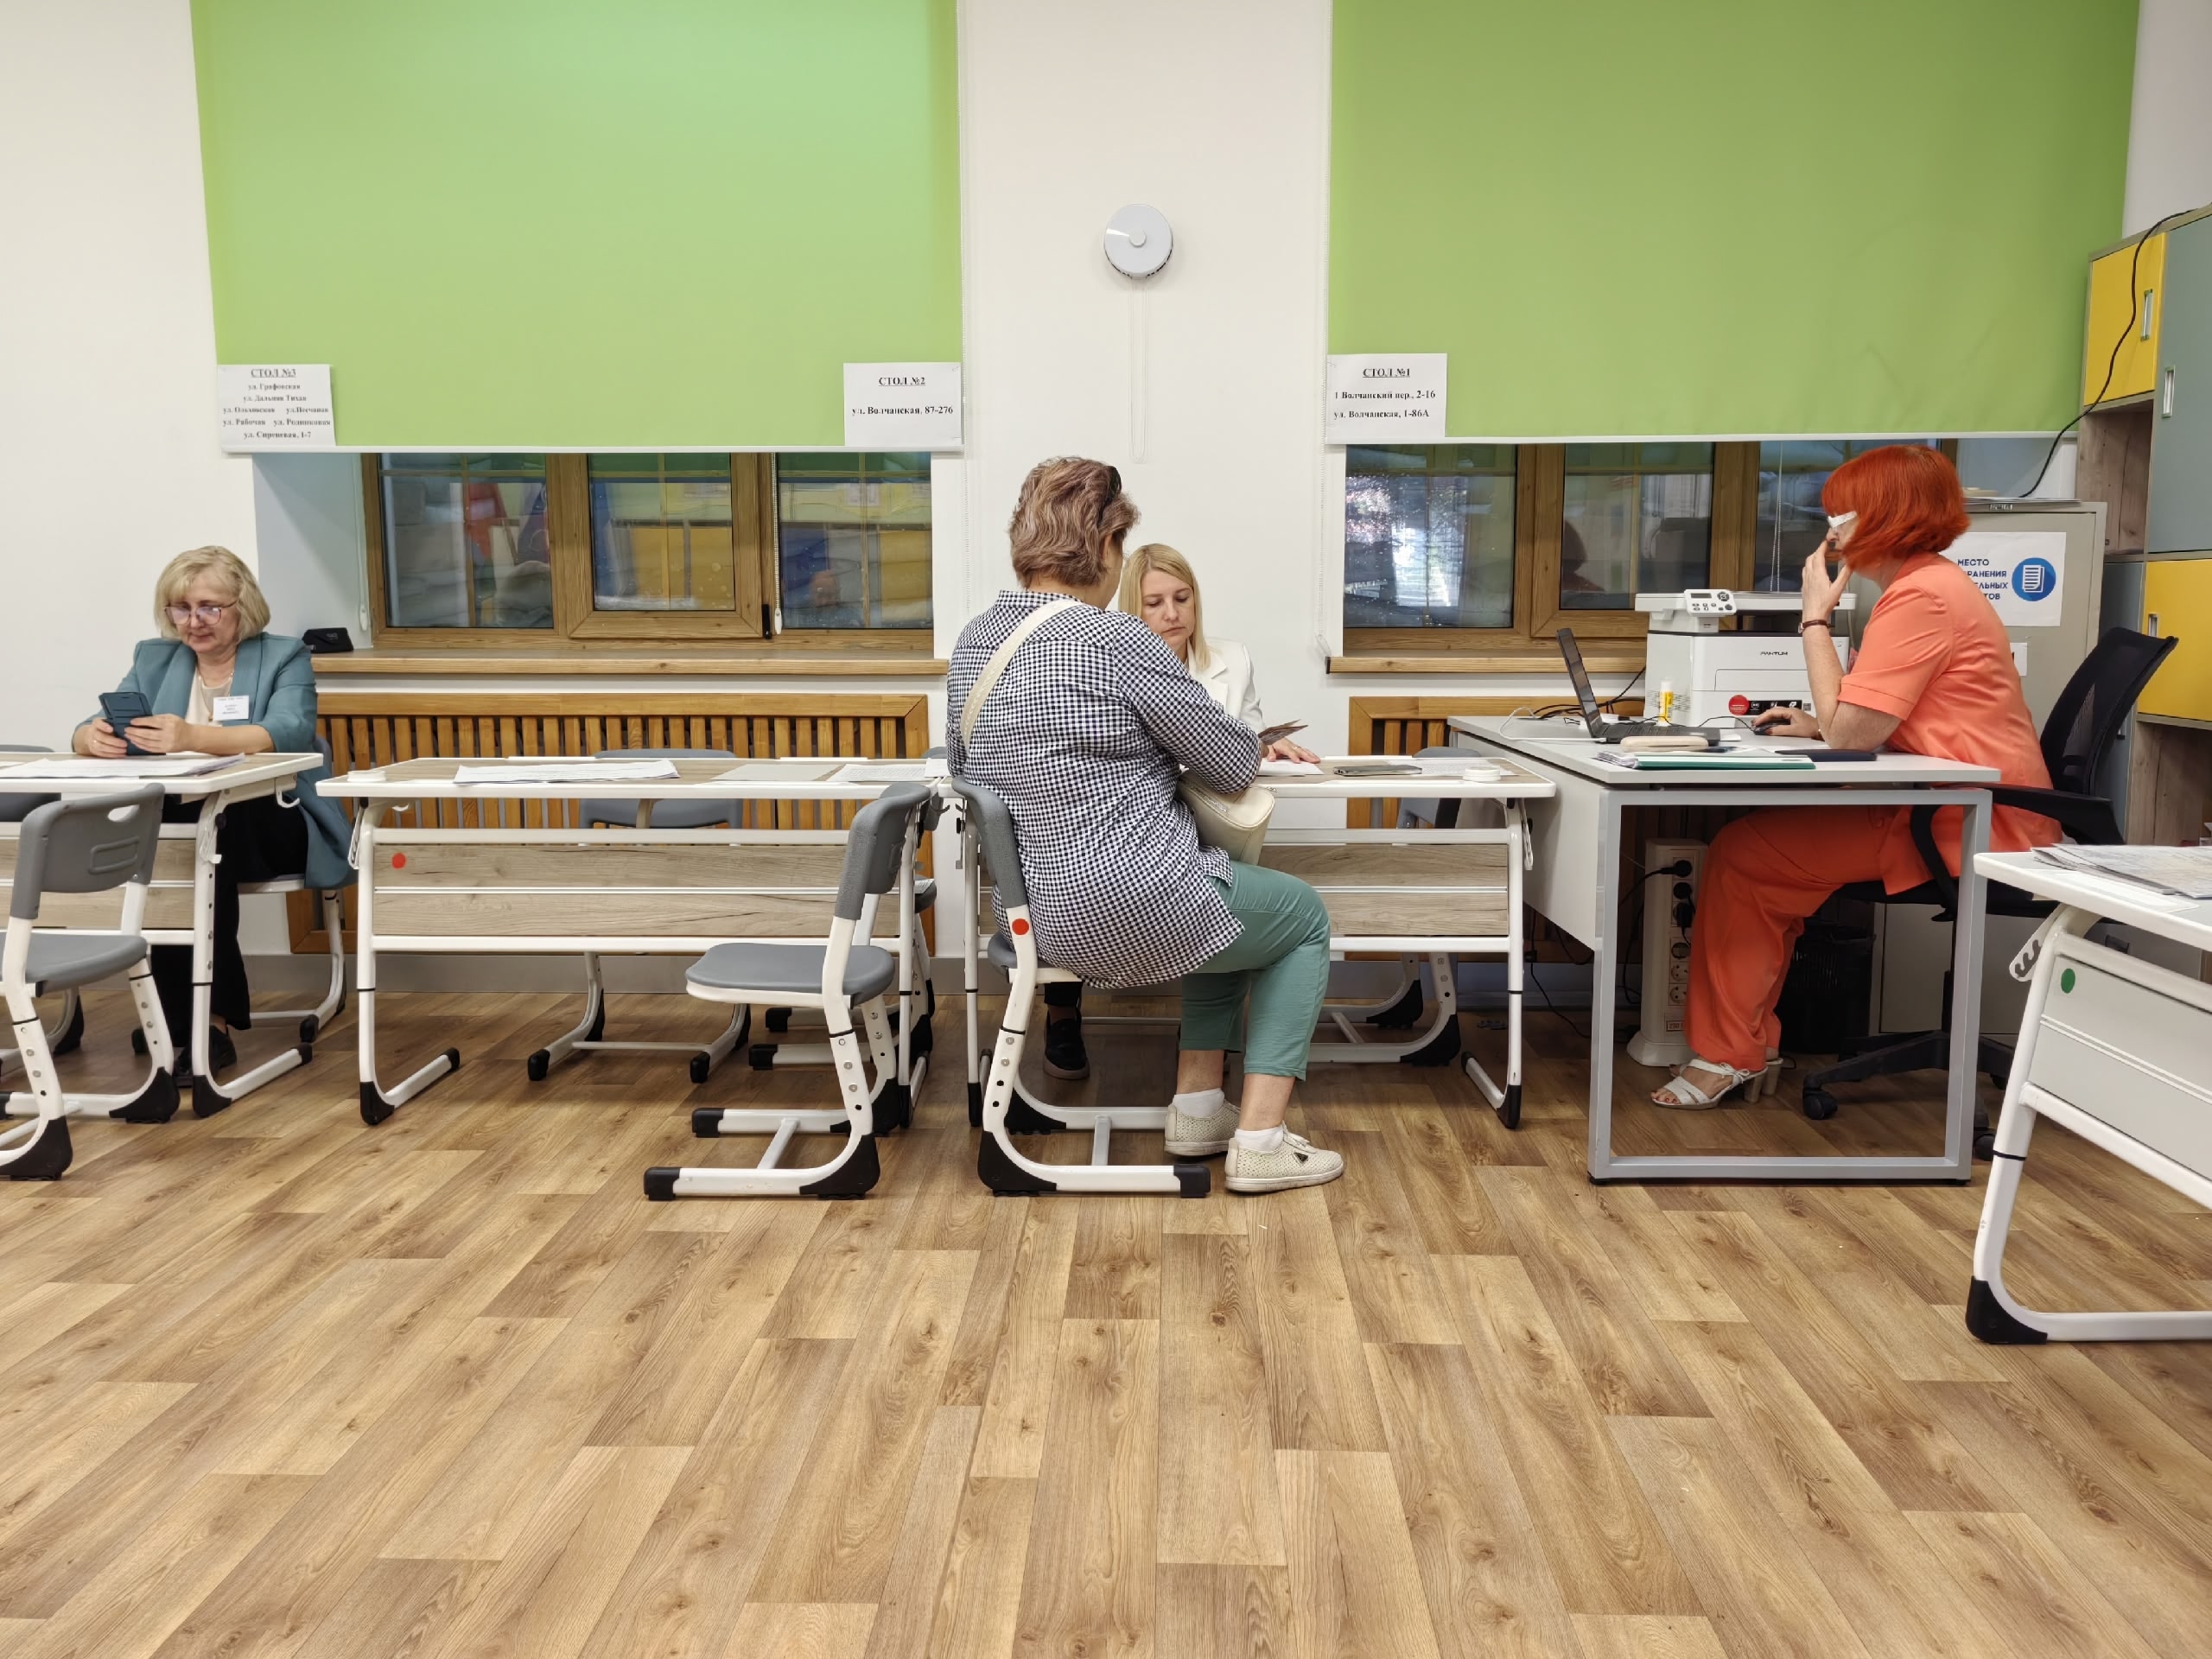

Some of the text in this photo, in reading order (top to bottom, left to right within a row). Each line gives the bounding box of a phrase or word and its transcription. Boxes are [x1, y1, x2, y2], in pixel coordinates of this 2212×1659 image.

[251, 368, 296, 378] СТОЛ №3
[1363, 368, 1410, 378] СТОЛ №1
[879, 377, 925, 385] СТОЛ №2
[1342, 391, 1393, 399] Волчанский
[1416, 390, 1436, 398] 2-16
[852, 405, 953, 416] ул. Волчанская, 87-276
[1334, 411, 1346, 420] ул.
[1349, 410, 1402, 419] Волчанская,
[1957, 558, 1990, 567] МЕСТО
